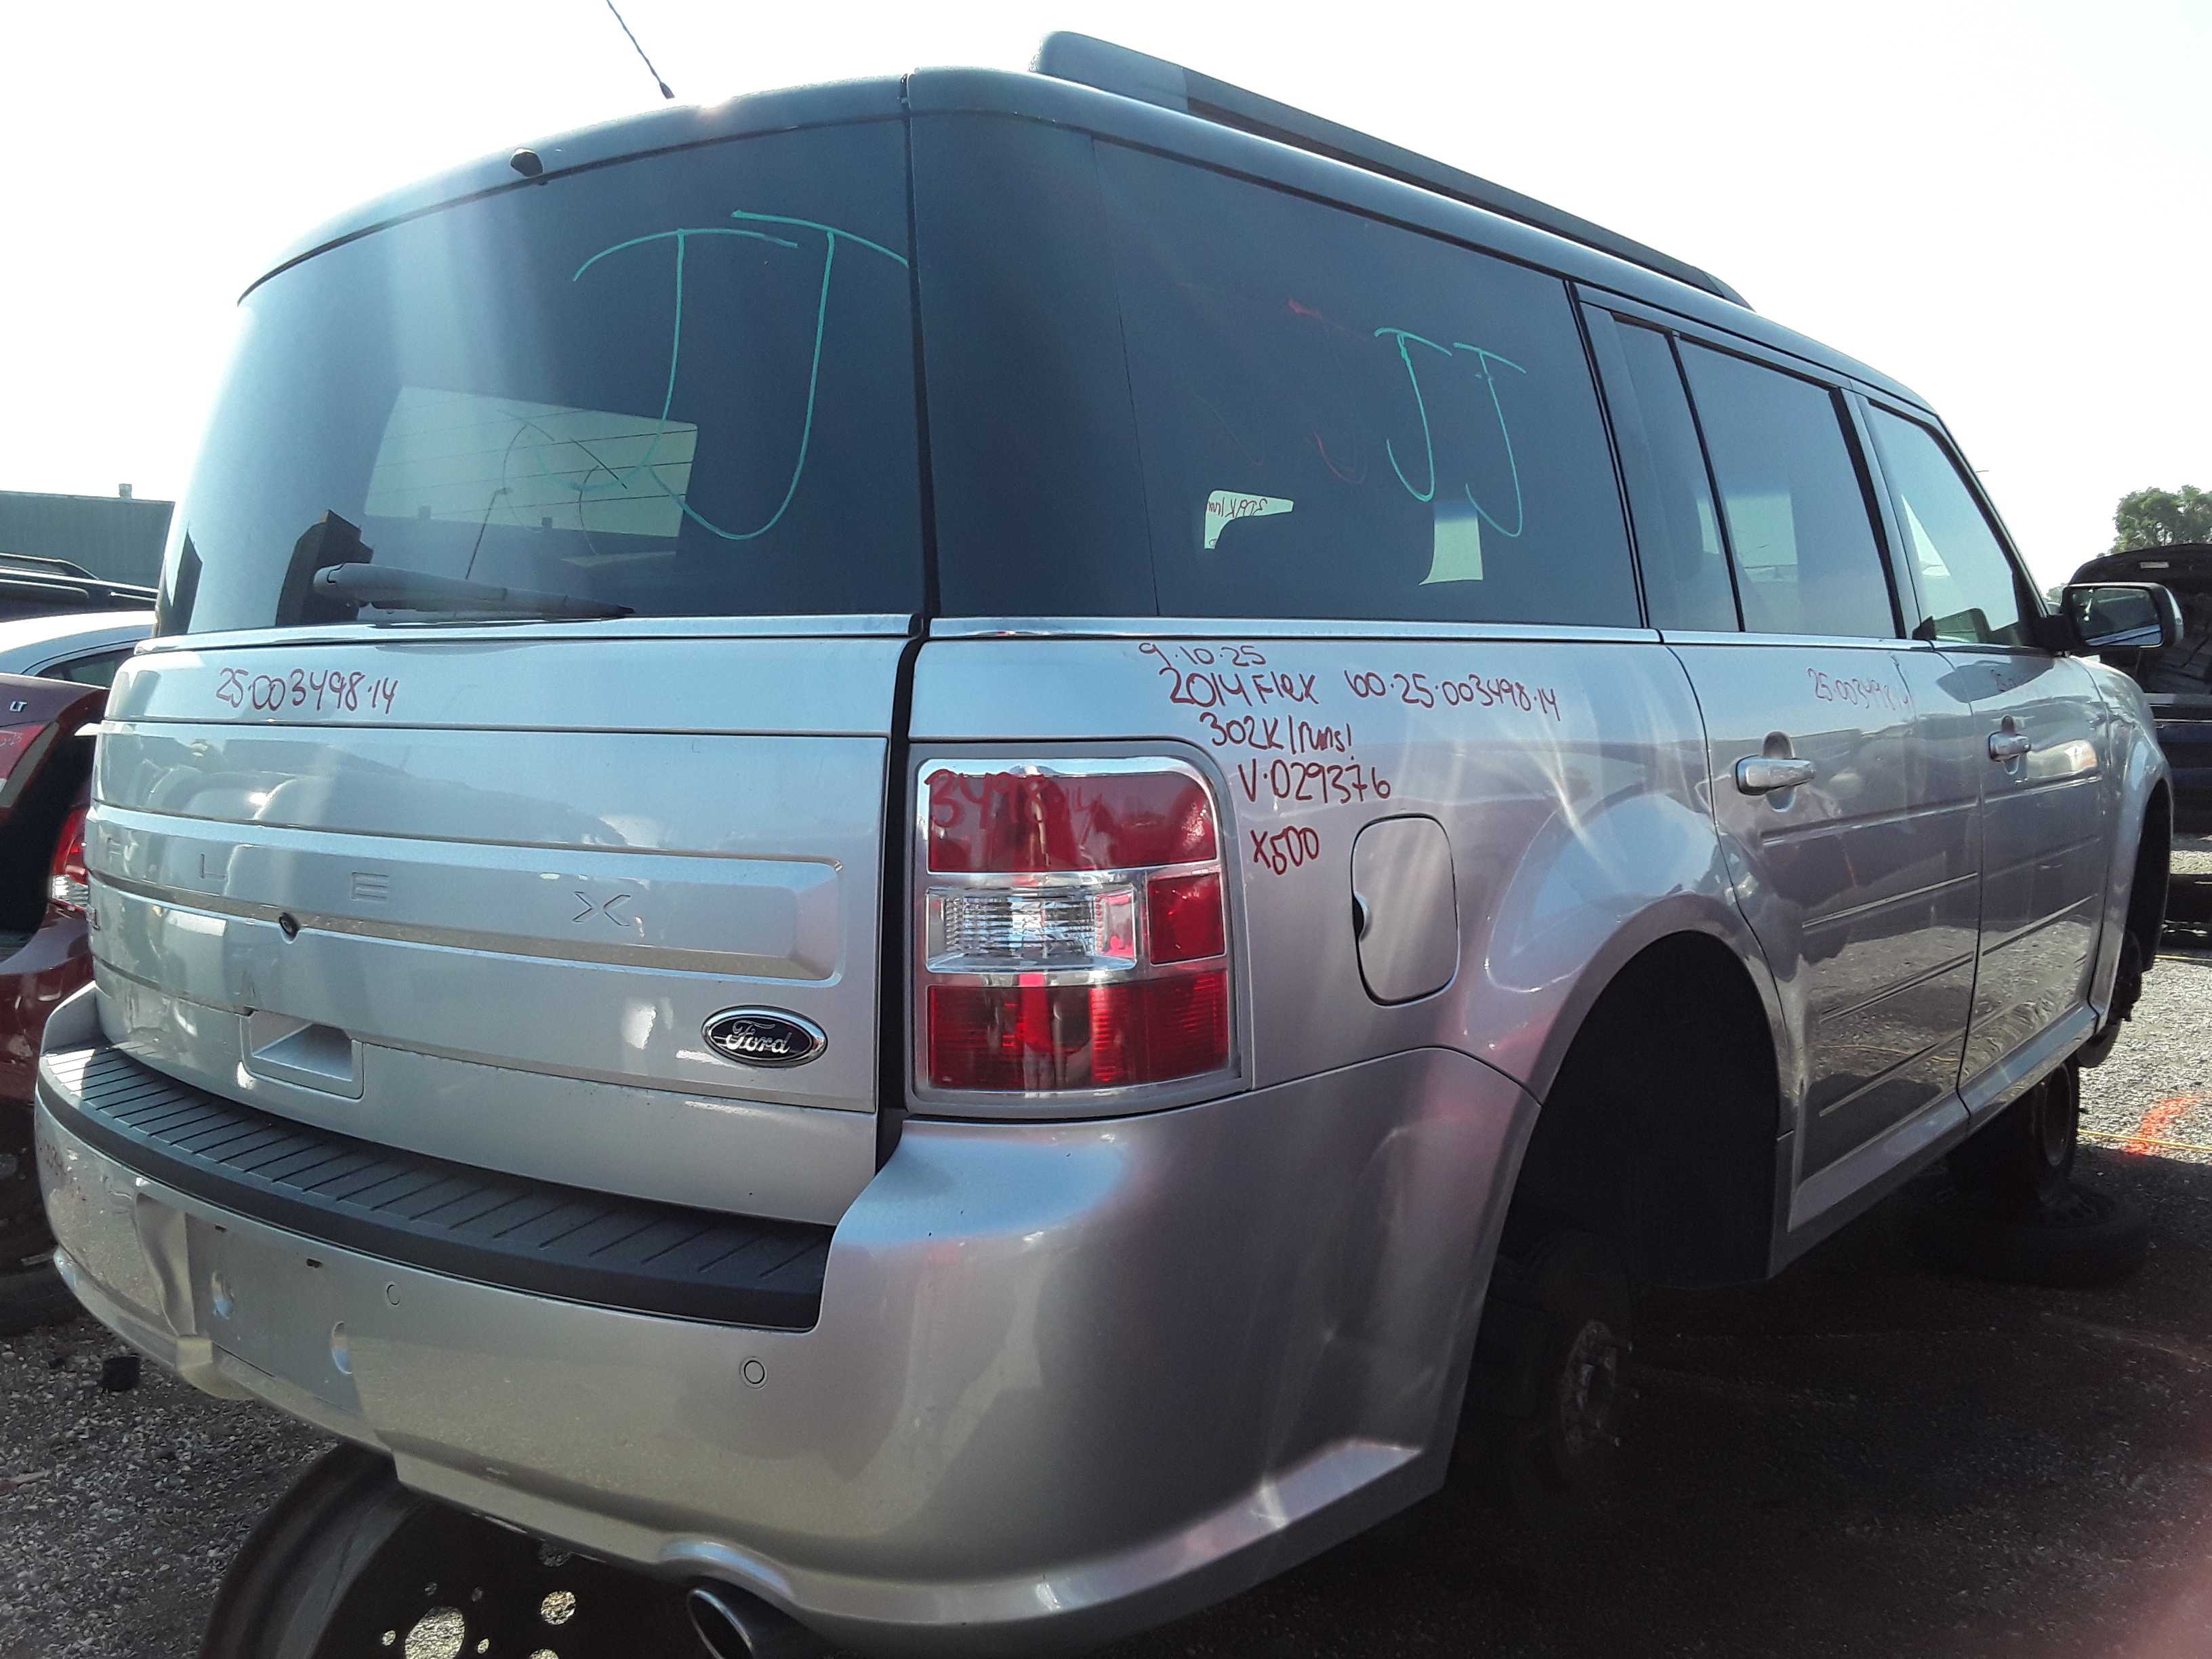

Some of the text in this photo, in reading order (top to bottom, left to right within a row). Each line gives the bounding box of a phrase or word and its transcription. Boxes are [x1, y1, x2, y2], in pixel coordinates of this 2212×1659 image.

[1158, 666, 1253, 708] 2014
[9, 700, 28, 712] LT
[722, 1019, 793, 1054] Ford
